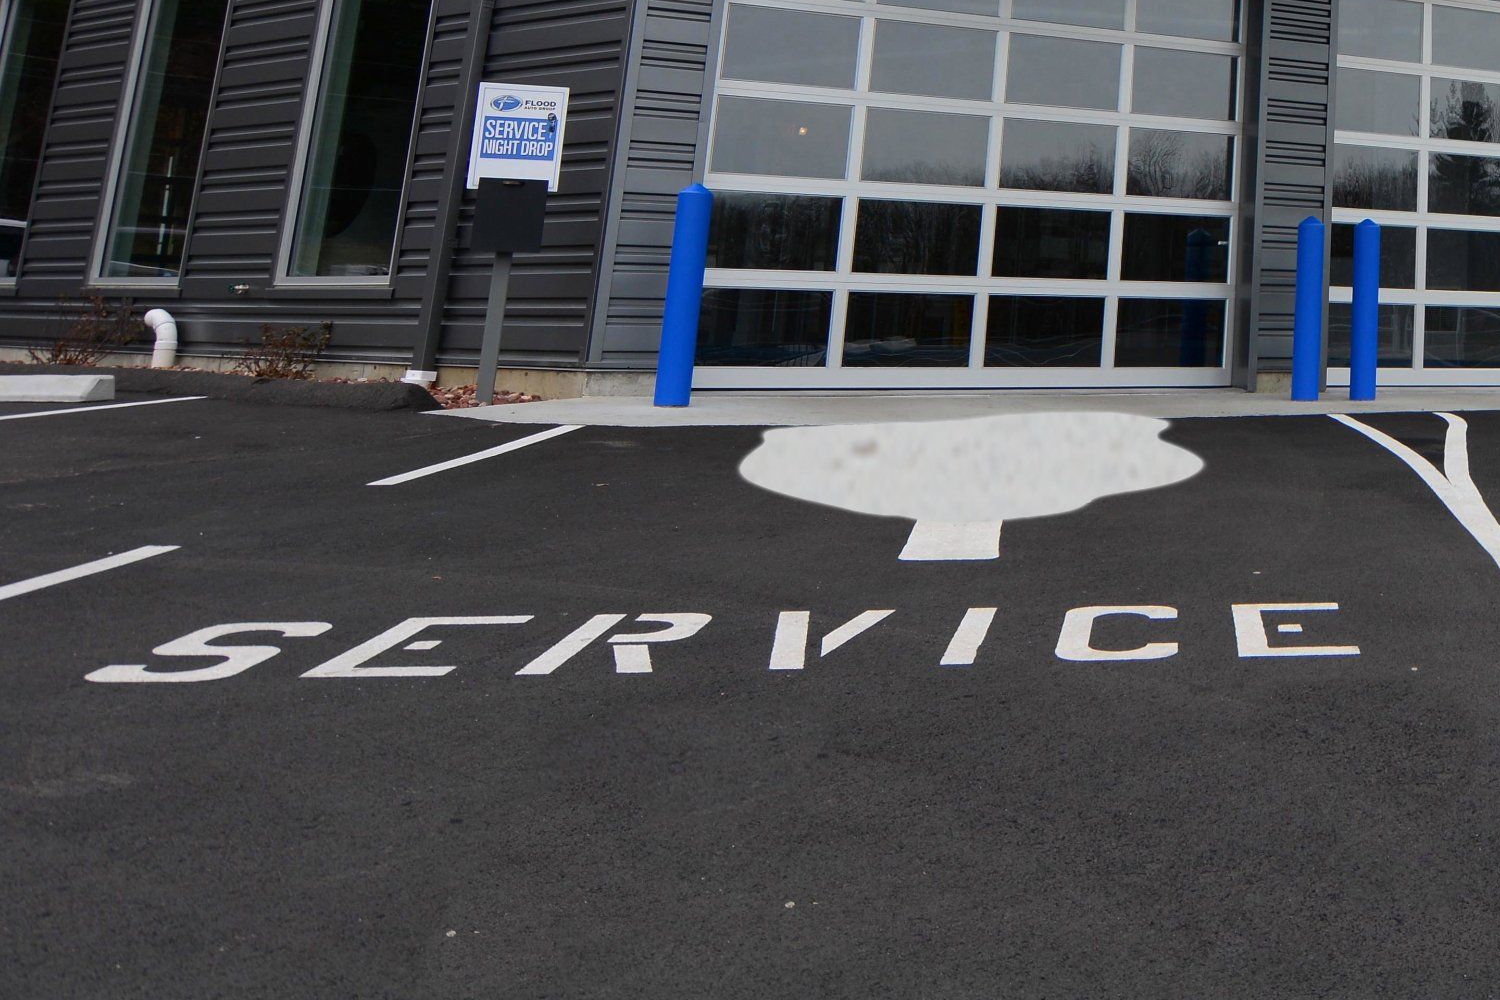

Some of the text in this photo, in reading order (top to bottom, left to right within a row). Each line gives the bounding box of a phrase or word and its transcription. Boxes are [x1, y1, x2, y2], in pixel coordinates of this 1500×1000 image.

[525, 100, 557, 108] FLOOD
[485, 120, 547, 140] SERVICE
[483, 139, 553, 156] NIGHT DROP
[85, 602, 1361, 683] SERVICE
